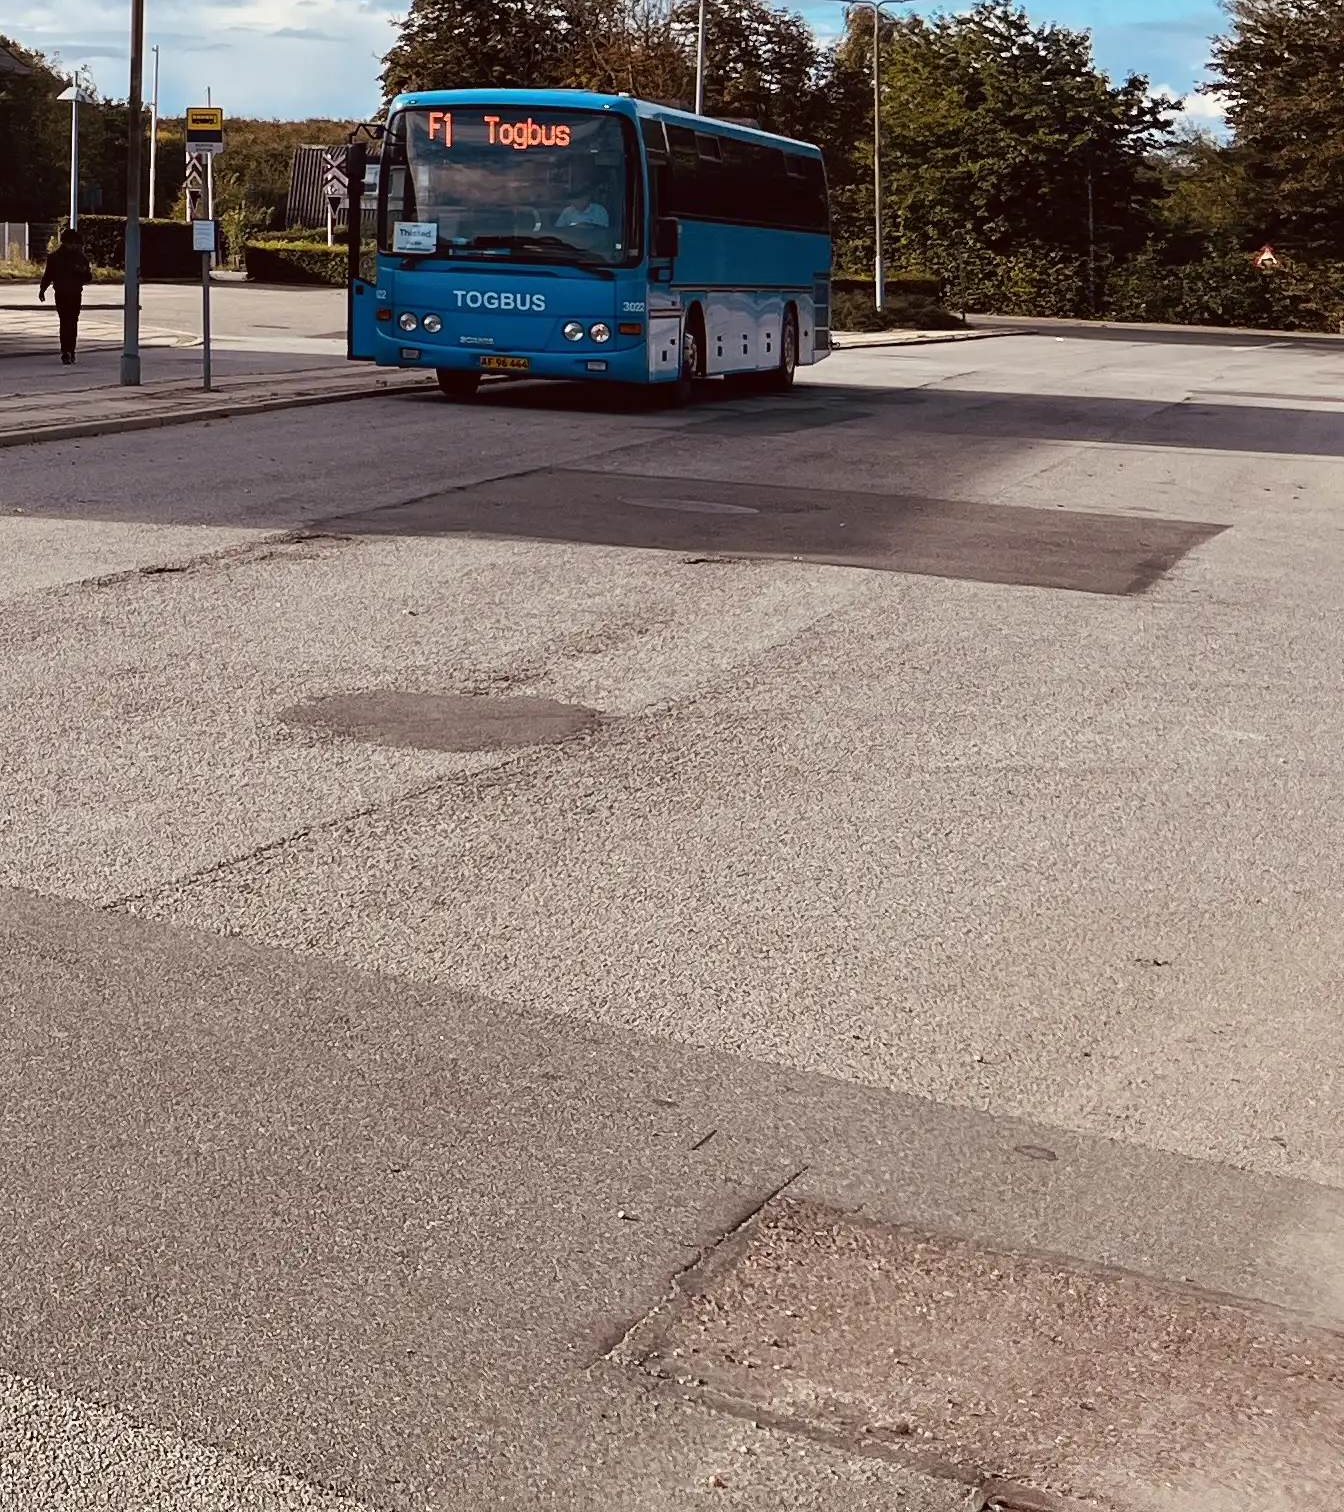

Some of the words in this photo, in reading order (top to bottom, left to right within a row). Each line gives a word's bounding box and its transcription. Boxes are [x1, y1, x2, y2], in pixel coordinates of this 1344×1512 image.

[429, 111, 452, 148] F1
[483, 115, 571, 149] Togbus
[453, 290, 546, 311] TOGBUS
[622, 301, 645, 312] 3022
